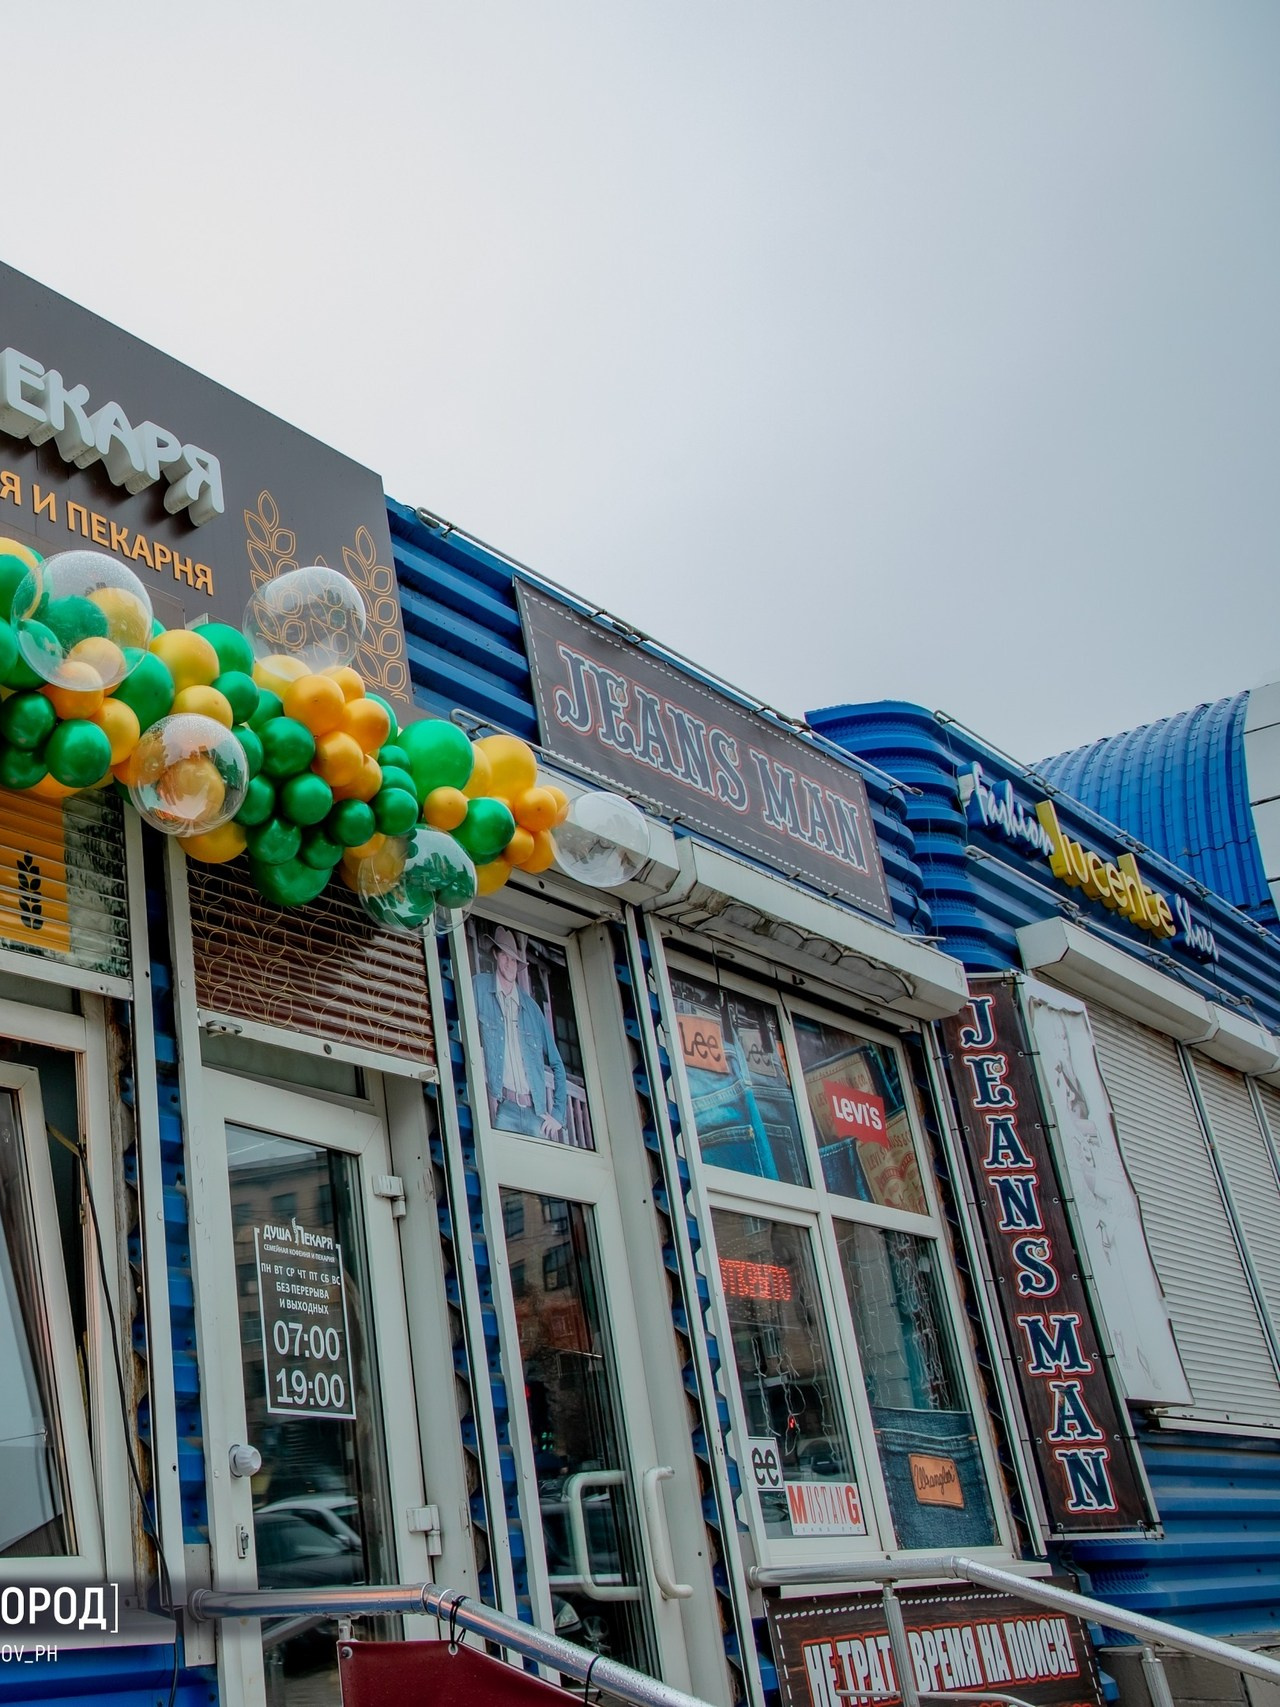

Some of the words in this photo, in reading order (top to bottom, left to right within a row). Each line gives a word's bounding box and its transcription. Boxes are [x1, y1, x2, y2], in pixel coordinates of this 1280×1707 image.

[32, 484, 57, 522] И
[66, 501, 214, 596] ПЕКАРНЯ
[554, 642, 749, 814] JEANS
[751, 748, 871, 875] MAN
[679, 1021, 721, 1062] Lee
[263, 1224, 292, 1242] ДУША
[261, 1262, 272, 1273] ПН
[274, 1265, 283, 1275] ВТ
[286, 1267, 295, 1277] СР
[297, 1269, 306, 1279] ЧТ
[309, 1271, 318, 1281] ПТ
[320, 1273, 329, 1283] СБ
[332, 1275, 341, 1285] ВС
[959, 995, 1058, 1298] JEANS
[1018, 1314, 1122, 1514] MAN
[276, 1281, 290, 1293] БЕЗ
[291, 1284, 330, 1300] ПЕРЕРЫВА
[279, 1298, 286, 1308] И
[286, 1299, 329, 1315] ВЫХОДНЫХ
[273, 1320, 340, 1361] 07:00
[276, 1367, 345, 1408] 19:00
[751, 1447, 780, 1487] ee
[787, 1485, 861, 1525] MUSTANG
[803, 1643, 843, 1707] НЕ
[835, 1635, 898, 1706] ТРАТ
[908, 1625, 983, 1693] ВРЕМЯ
[976, 1621, 1012, 1682] НА
[1002, 1618, 1079, 1680] ПОИСК!
